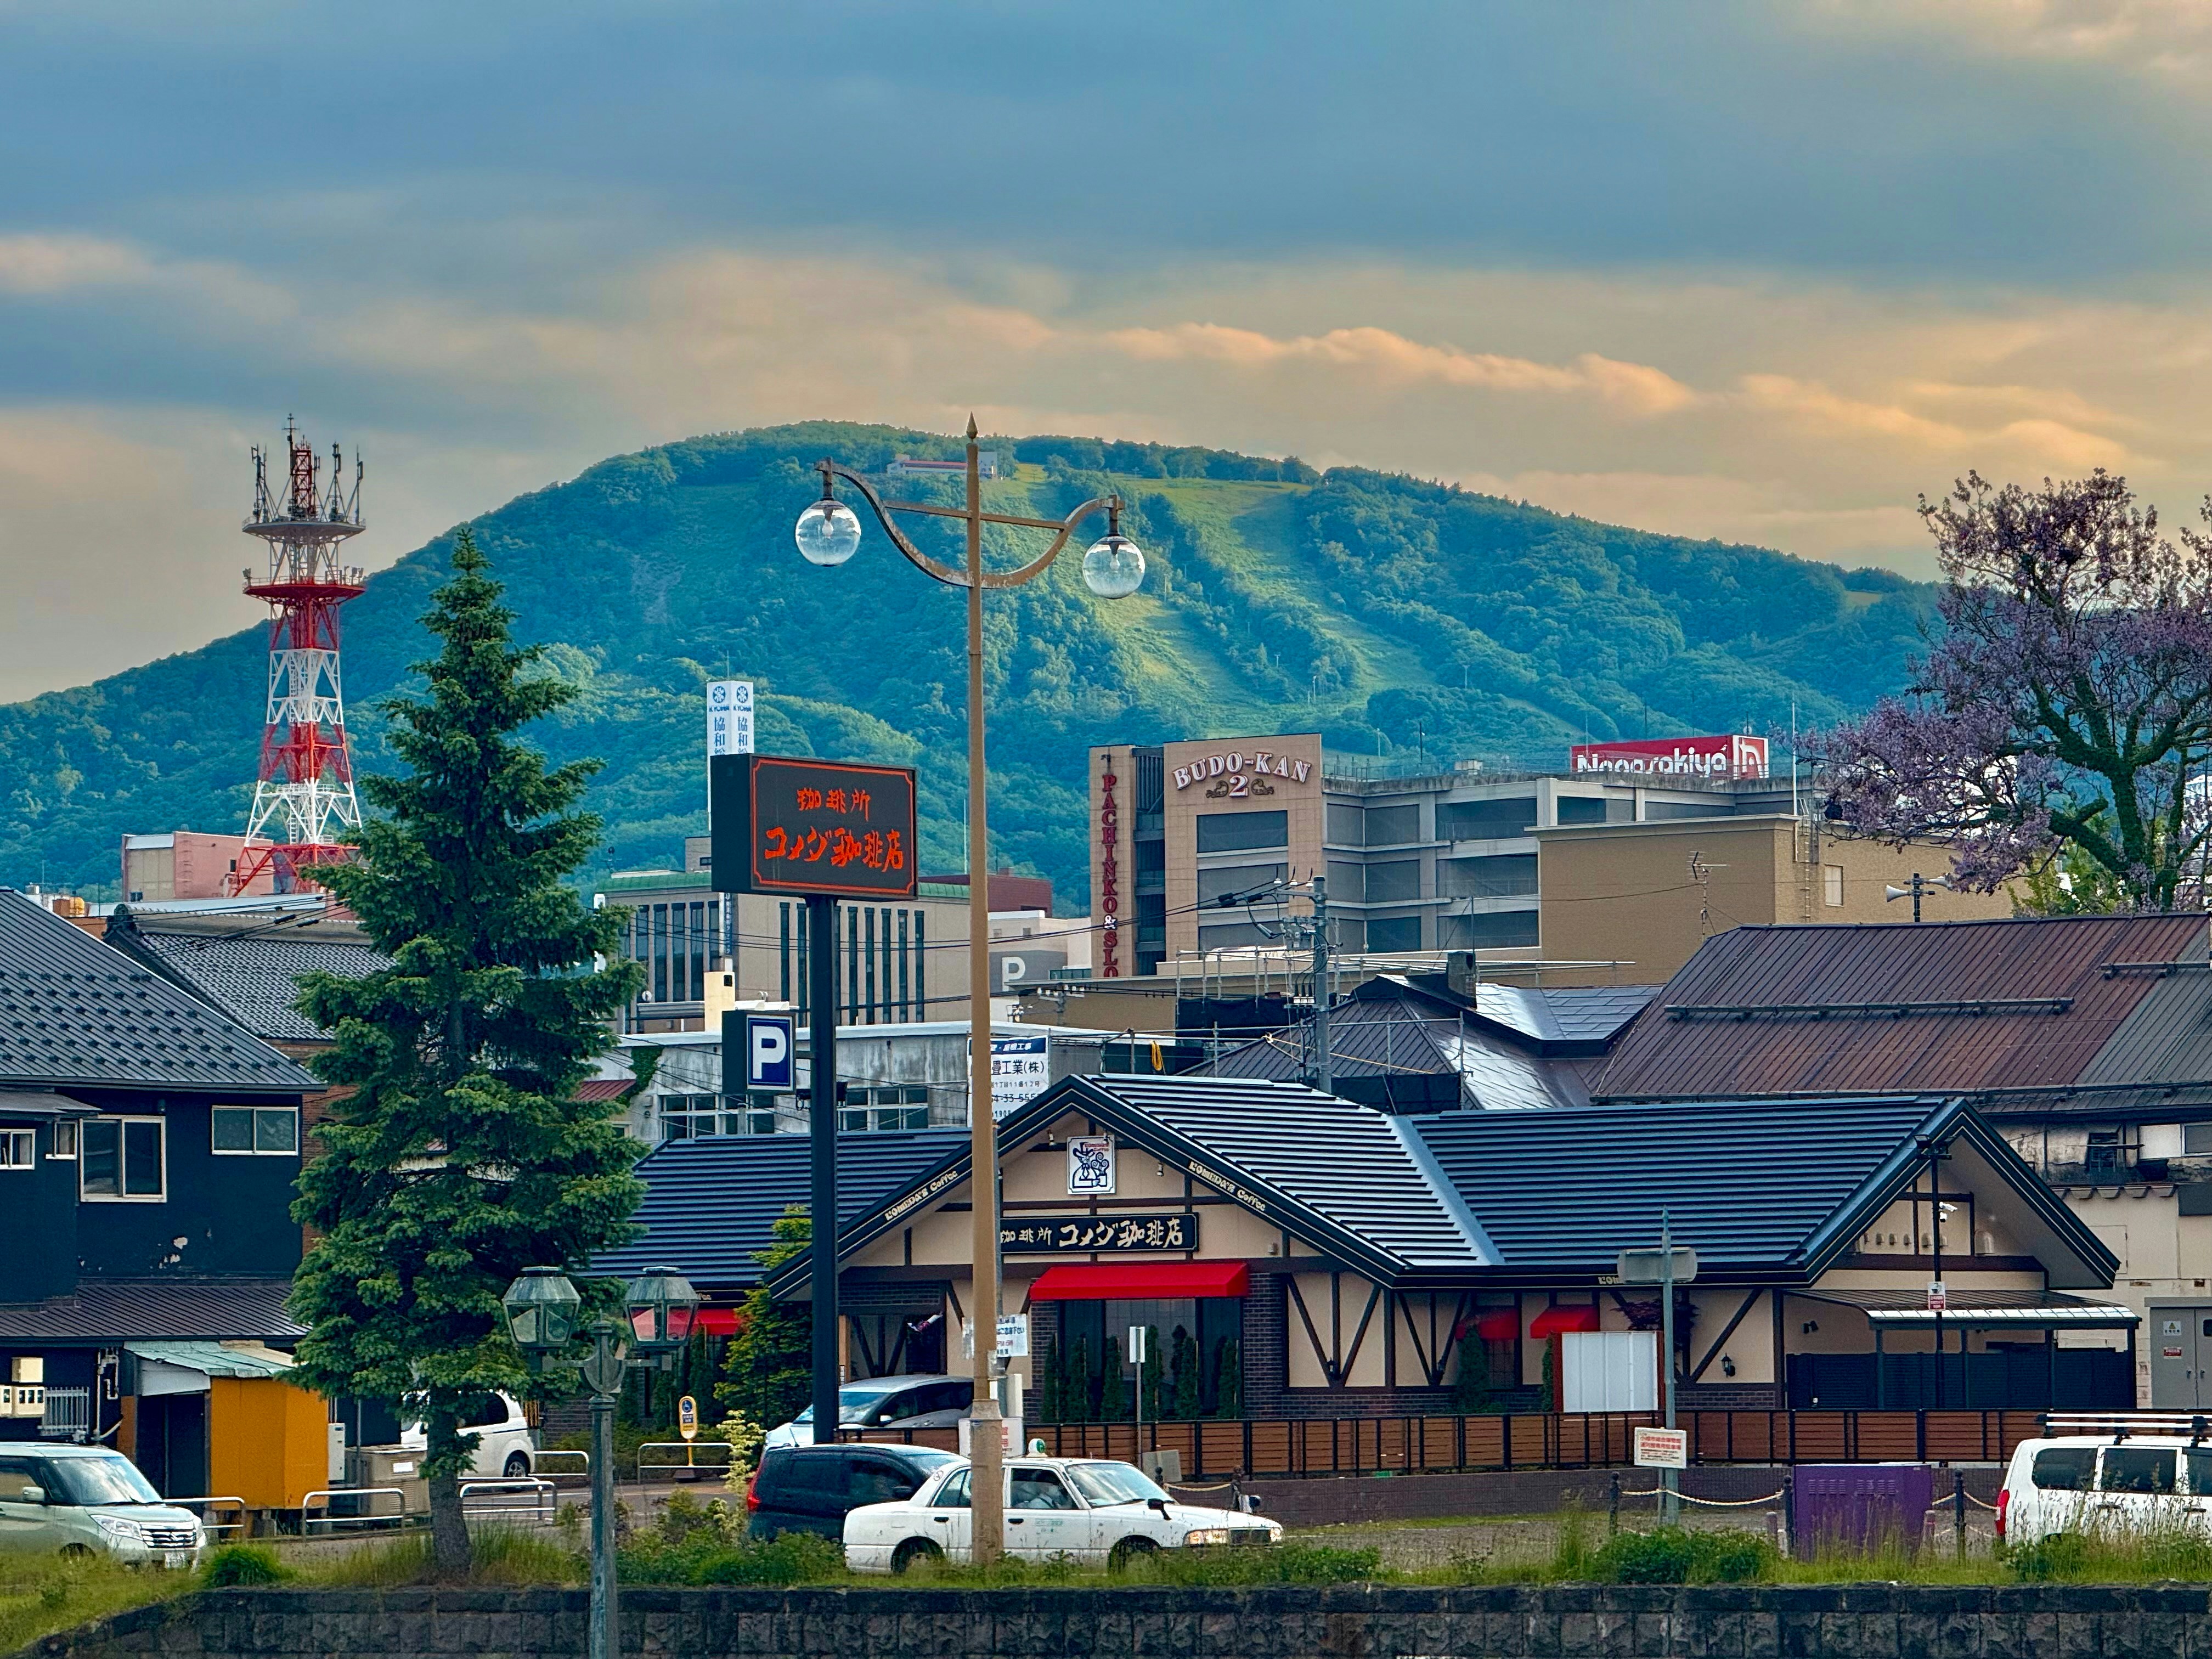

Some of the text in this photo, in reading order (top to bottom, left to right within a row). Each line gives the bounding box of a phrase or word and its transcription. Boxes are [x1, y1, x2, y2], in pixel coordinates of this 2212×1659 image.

[1172, 752, 1311, 790] BUDO-KAN
[1228, 775, 1249, 797] 2
[797, 787, 871, 822] 珈琲所
[765, 825, 904, 872] コメダ珈琲店
[1102, 774, 1118, 914] PACHINKO
[1104, 914, 1117, 930] &
[1002, 957, 1025, 991] P
[752, 1025, 786, 1079] P
[930, 1171, 958, 1191] Coffee
[1188, 1161, 1266, 1211] KOMEDA'S Coffee
[1059, 1217, 1183, 1248] コメダ珈琲店
